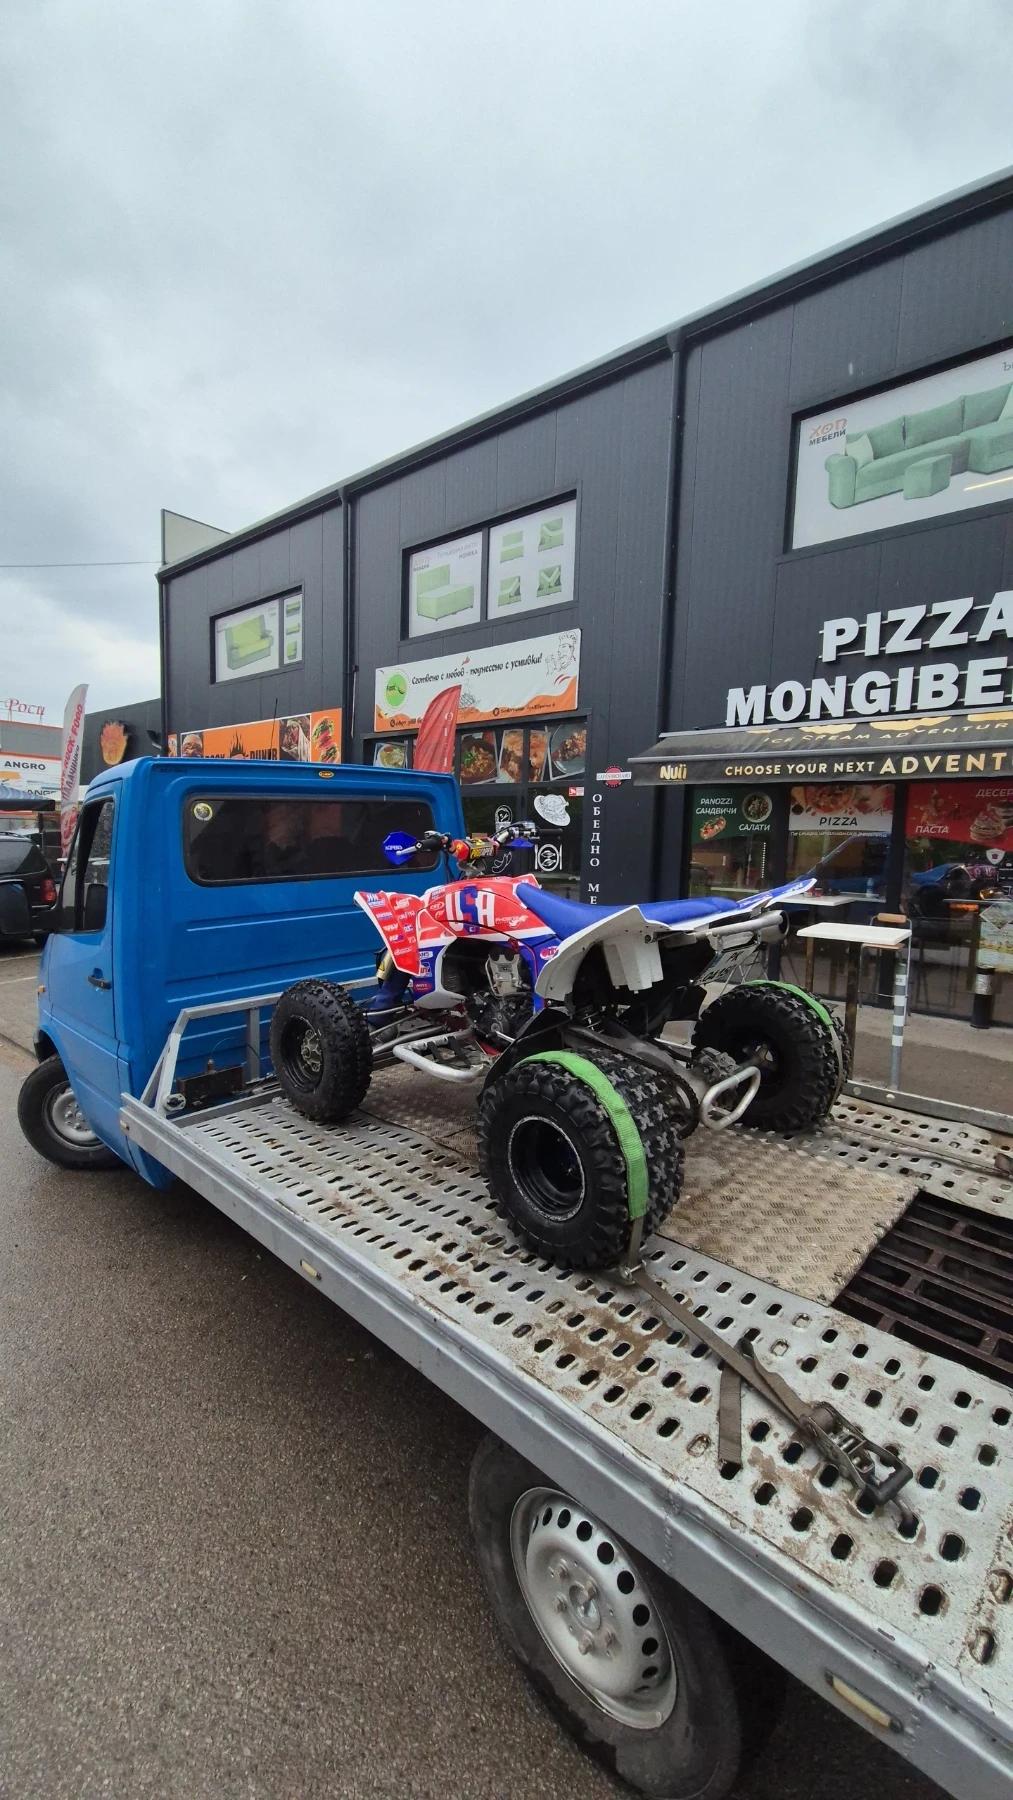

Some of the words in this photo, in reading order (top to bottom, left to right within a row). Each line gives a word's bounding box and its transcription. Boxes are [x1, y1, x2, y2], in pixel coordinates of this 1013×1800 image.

[808, 429, 847, 447] МЕБЕЛИ
[821, 590, 1013, 662] PIZZA
[726, 657, 1013, 727] MONGIBE
[764, 736, 793, 744] ICE
[802, 732, 871, 741] CREAM
[879, 722, 1009, 739] ADVENTUR
[4, 761, 46, 771] ANGRO
[660, 764, 687, 780] Nuii
[725, 764, 781, 777] CHOOSE
[786, 763, 827, 775] YOUR
[834, 762, 875, 774] NEXT
[879, 752, 1013, 776] ADVENT
[696, 807, 738, 815] САНДВИЧИ
[700, 798, 734, 806] PANOZZI
[590, 794, 603, 867] ОБЕДНО
[739, 823, 771, 831] САЛАТИ
[819, 817, 858, 827] PIZZA
[915, 825, 949, 834] ПАСТА
[445, 886, 496, 933] USA
